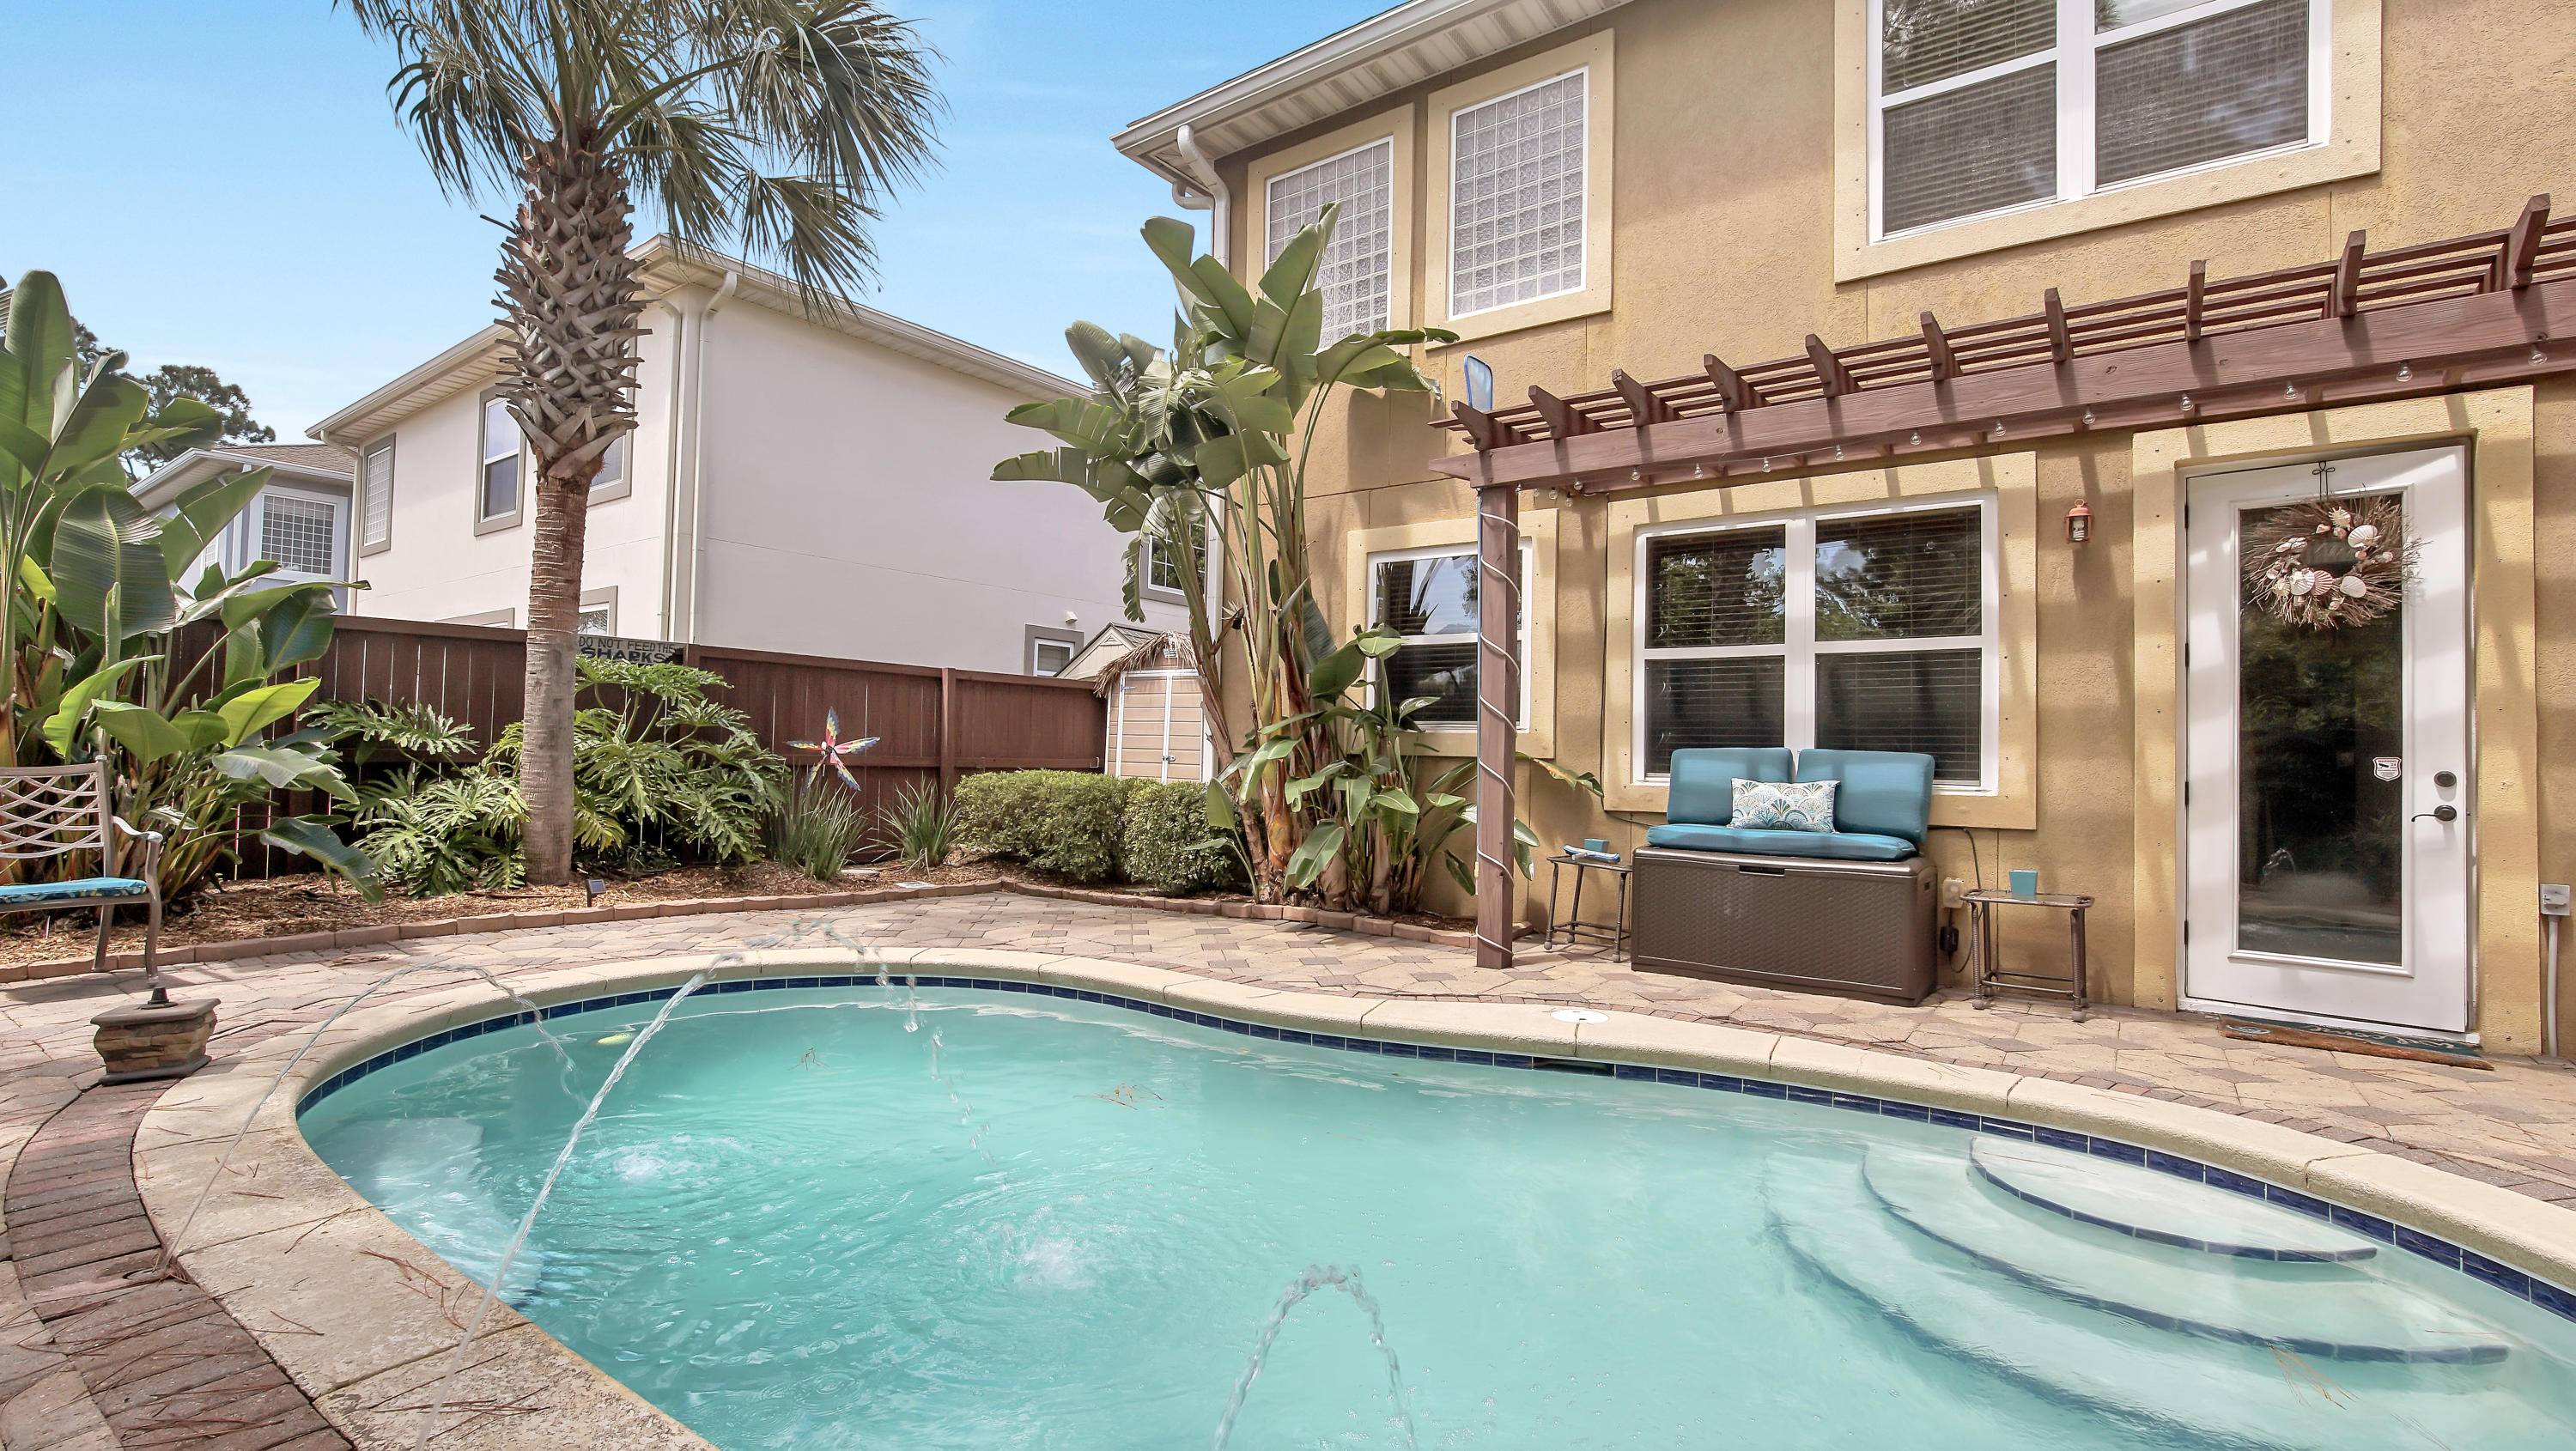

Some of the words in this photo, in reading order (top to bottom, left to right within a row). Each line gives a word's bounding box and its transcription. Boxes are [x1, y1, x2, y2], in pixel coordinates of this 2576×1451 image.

[579, 636, 593, 647] DO
[598, 638, 623, 649] NOT
[628, 641, 655, 652] FEED
[658, 643, 675, 653] THE
